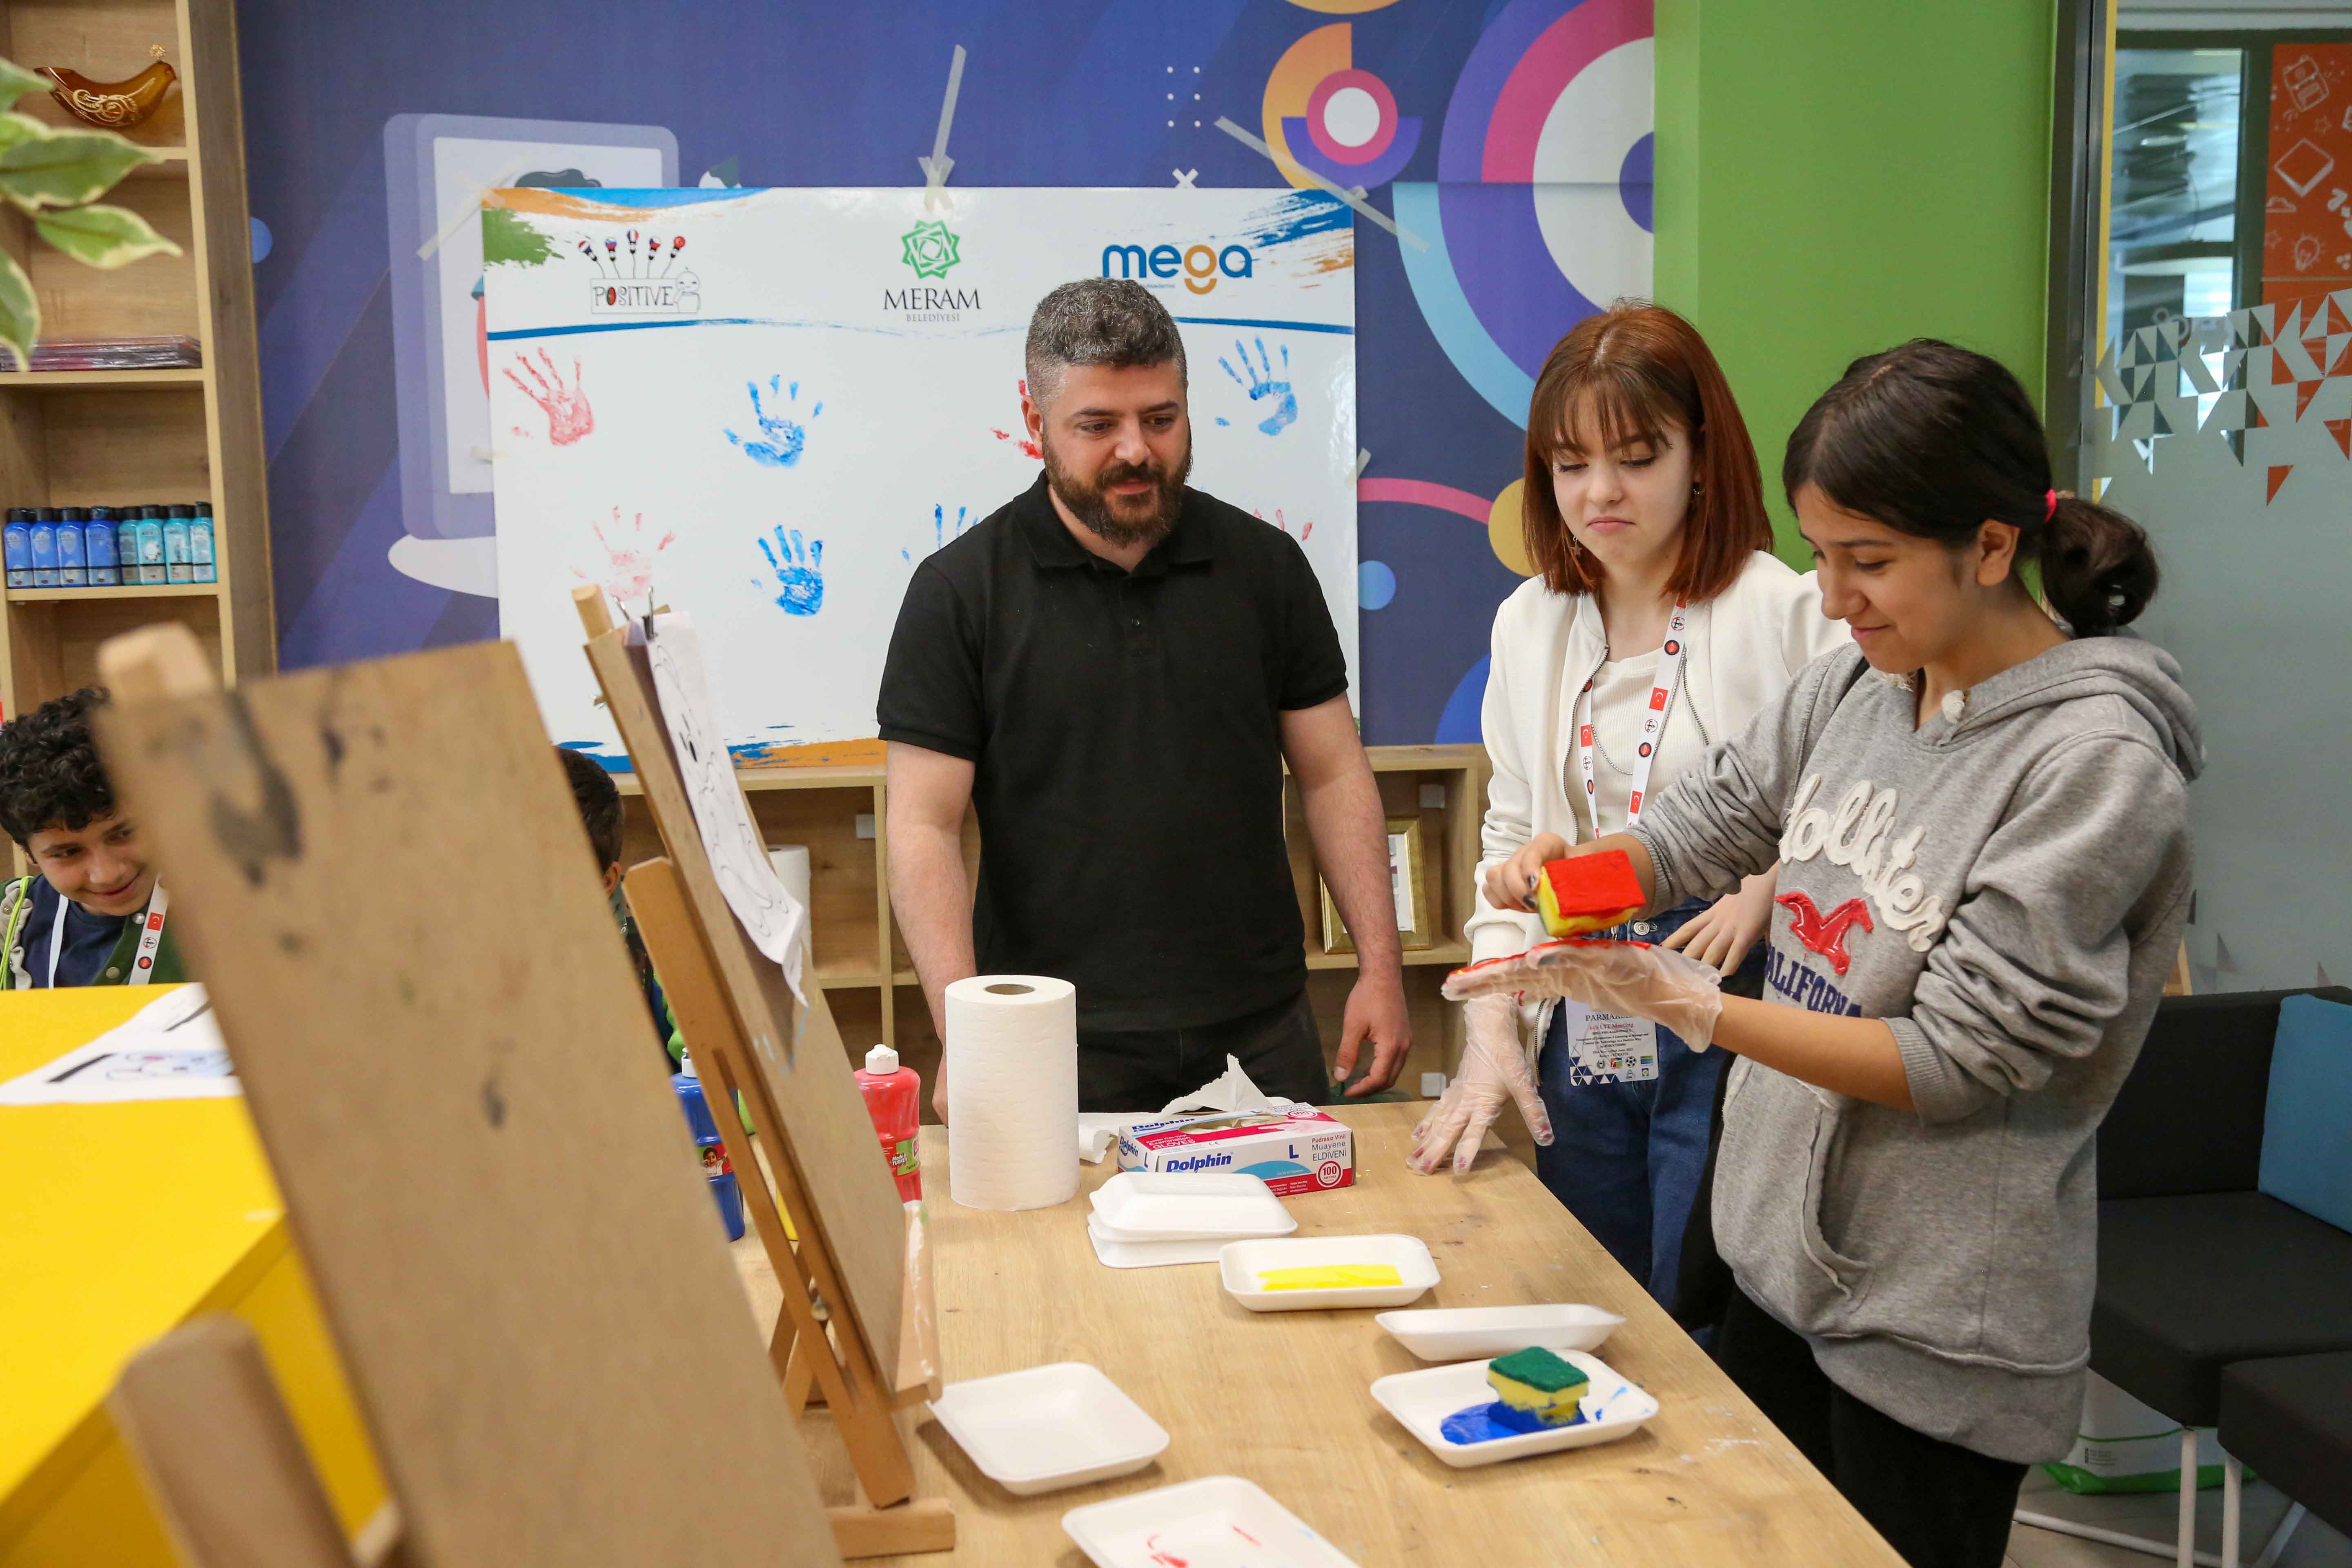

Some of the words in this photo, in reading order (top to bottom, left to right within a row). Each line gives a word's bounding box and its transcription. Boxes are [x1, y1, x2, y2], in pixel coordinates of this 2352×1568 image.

[1103, 244, 1252, 294] mega
[593, 285, 673, 306] POSITIVE
[883, 287, 982, 310] MERAM
[906, 312, 960, 322] BELEDİYESİ
[1120, 1136, 1138, 1157] Dolphin
[1149, 1136, 1191, 1146] Examination
[1153, 1139, 1196, 1149] GLOVES
[1312, 1141, 1346, 1151] Muayene
[1289, 1145, 1299, 1159] L
[1313, 1148, 1346, 1161] ELDİVENİ
[1167, 1153, 1232, 1173] Dolphin
[1323, 1166, 1337, 1176] 100
